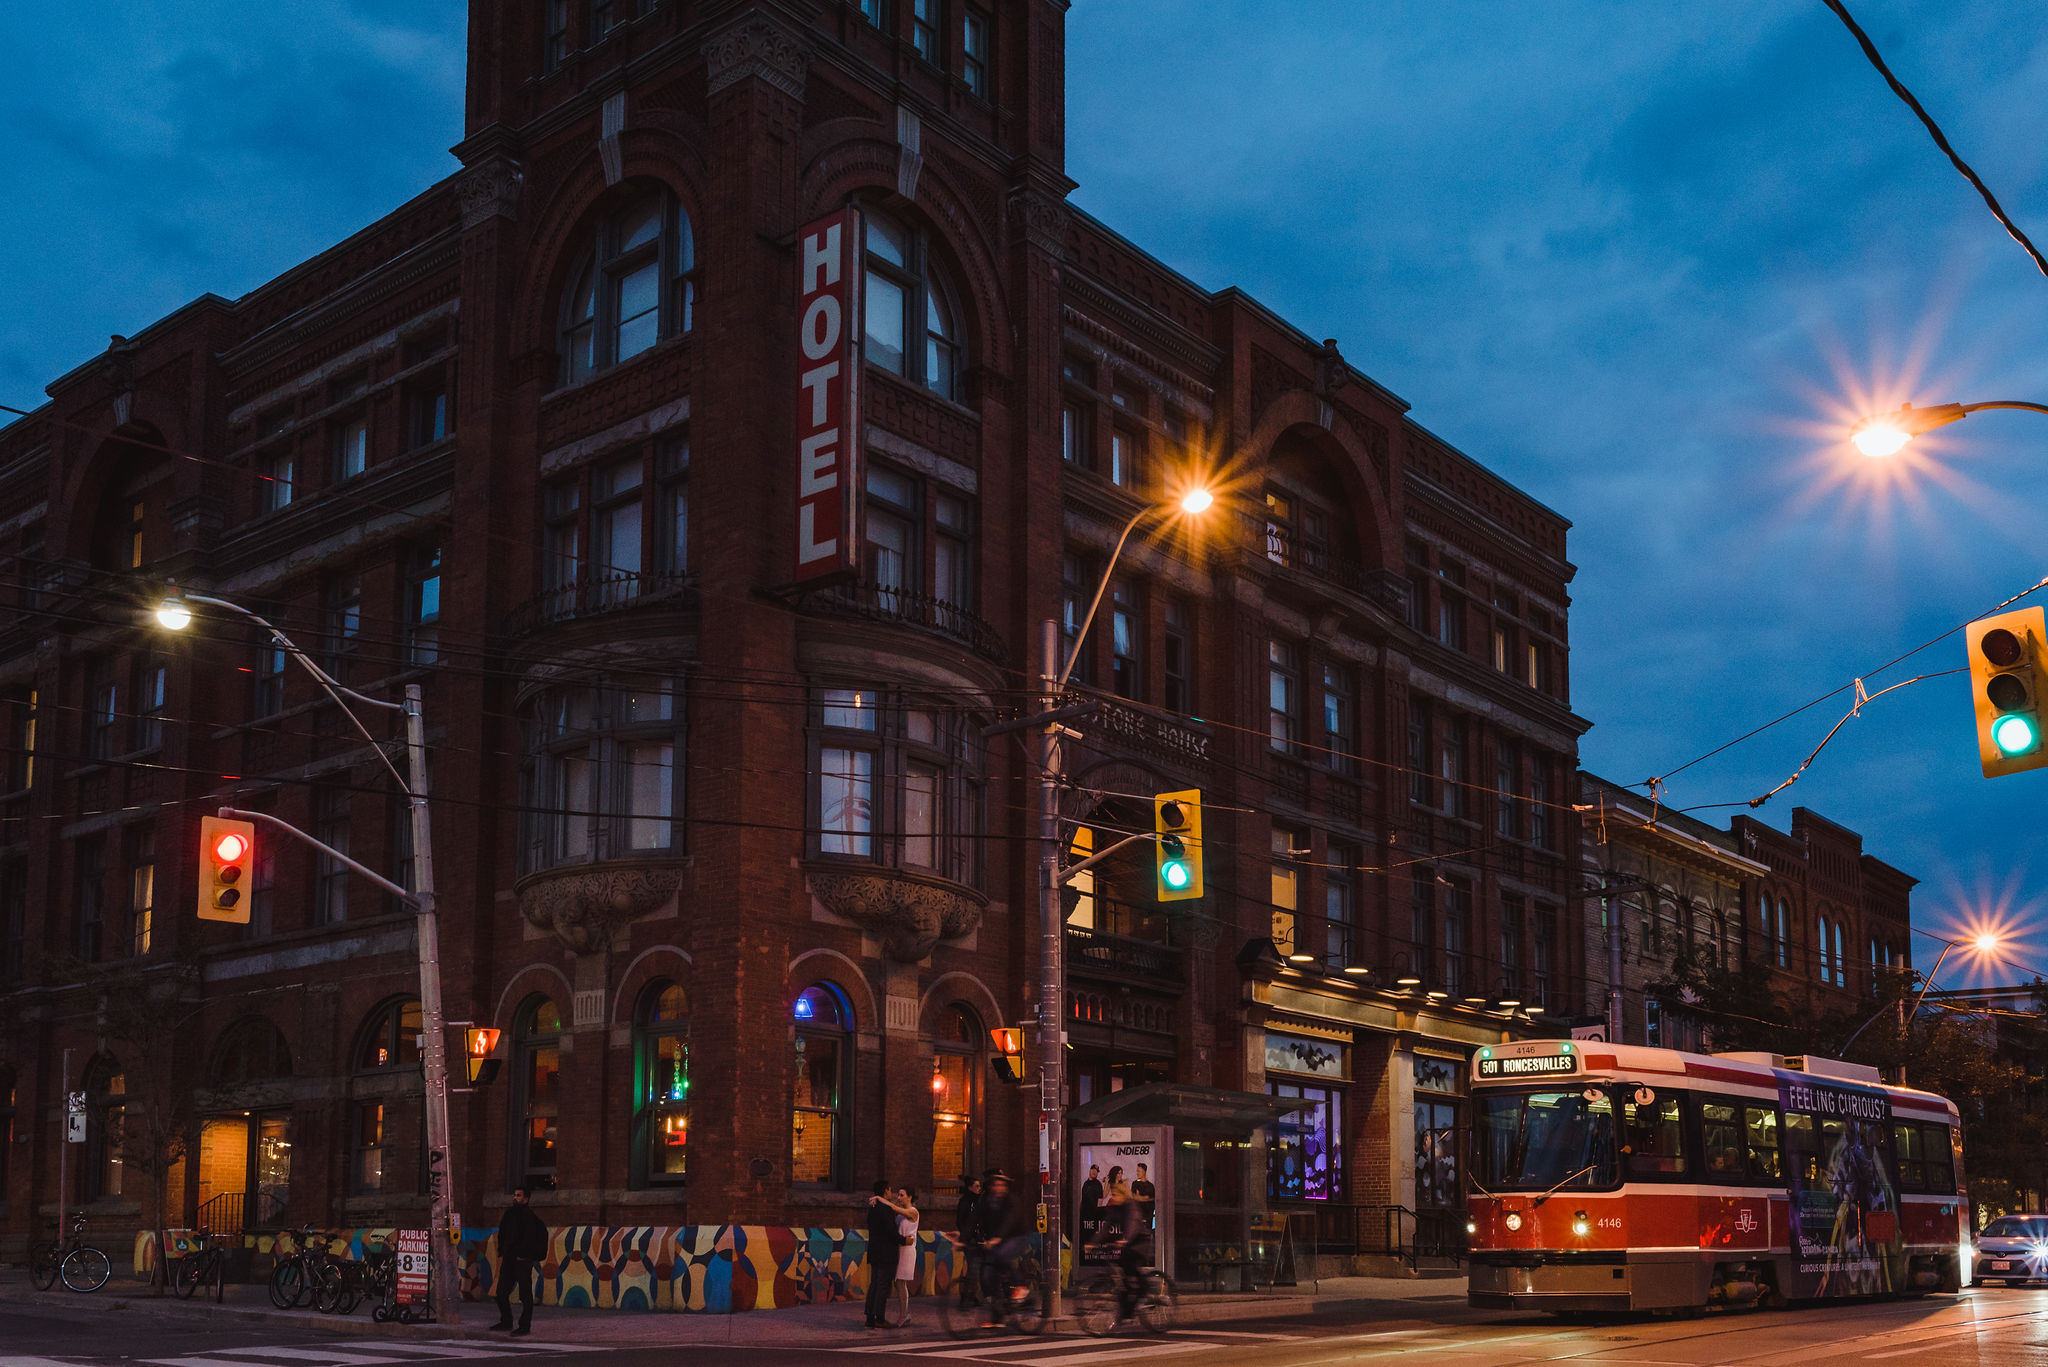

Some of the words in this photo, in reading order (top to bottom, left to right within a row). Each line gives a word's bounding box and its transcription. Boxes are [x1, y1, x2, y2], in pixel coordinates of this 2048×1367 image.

[799, 225, 841, 565] HOTEL
[1516, 1046, 1536, 1055] 4146
[1482, 1060, 1498, 1074] 501
[1503, 1056, 1572, 1073] RONCESVALLES
[1788, 1086, 1835, 1114] FEELING
[1838, 1093, 1886, 1120] CURIOUS?
[1116, 1146, 1150, 1156] INDIE88
[1083, 1220, 1095, 1230] THE
[1597, 1217, 1622, 1229] 4146
[400, 1229, 429, 1240] PUBLIC
[398, 1240, 429, 1253] PARKING
